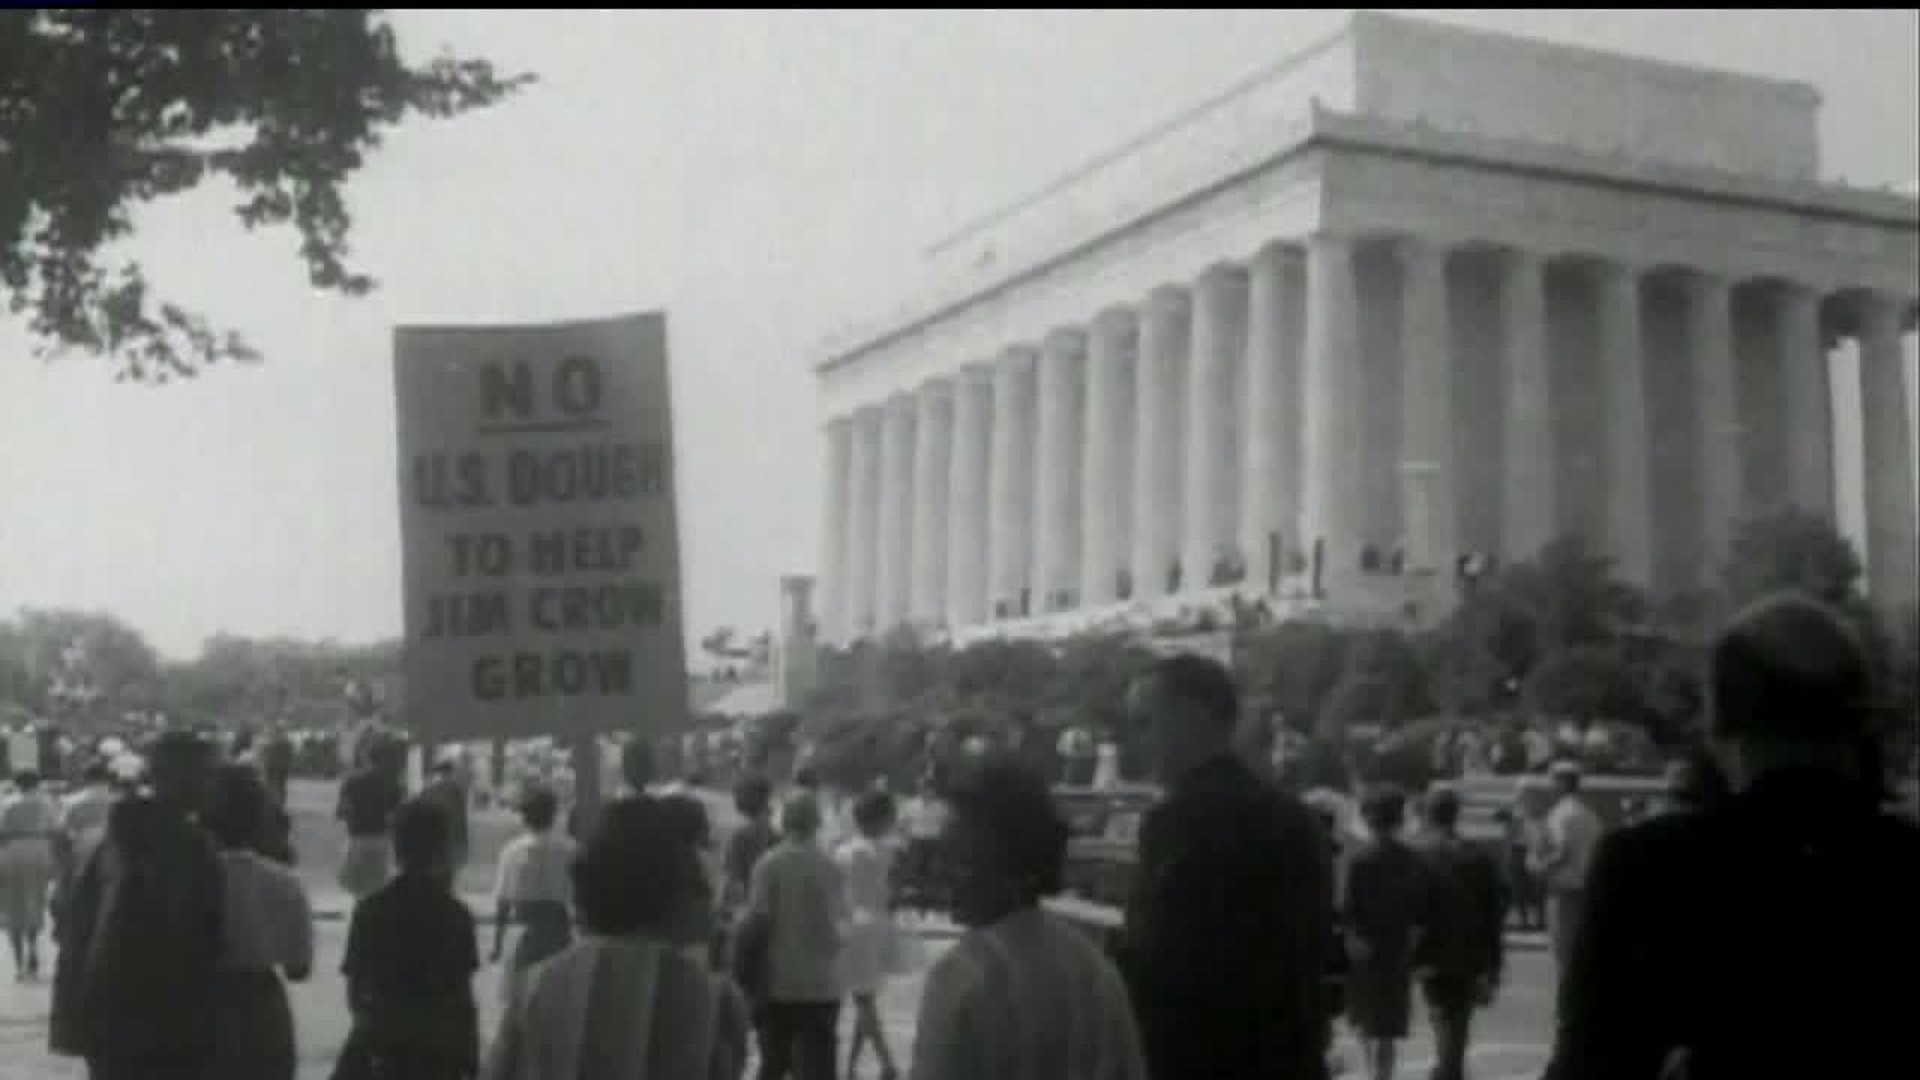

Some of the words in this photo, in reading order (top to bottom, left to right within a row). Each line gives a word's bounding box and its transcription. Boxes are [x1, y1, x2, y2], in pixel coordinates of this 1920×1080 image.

[479, 358, 602, 418] NO
[509, 443, 663, 505] DOUGH
[447, 532, 511, 577] TO
[530, 527, 643, 573] HELP
[421, 593, 509, 641] JIM
[528, 583, 664, 632] CROW
[472, 650, 632, 699] GROW
